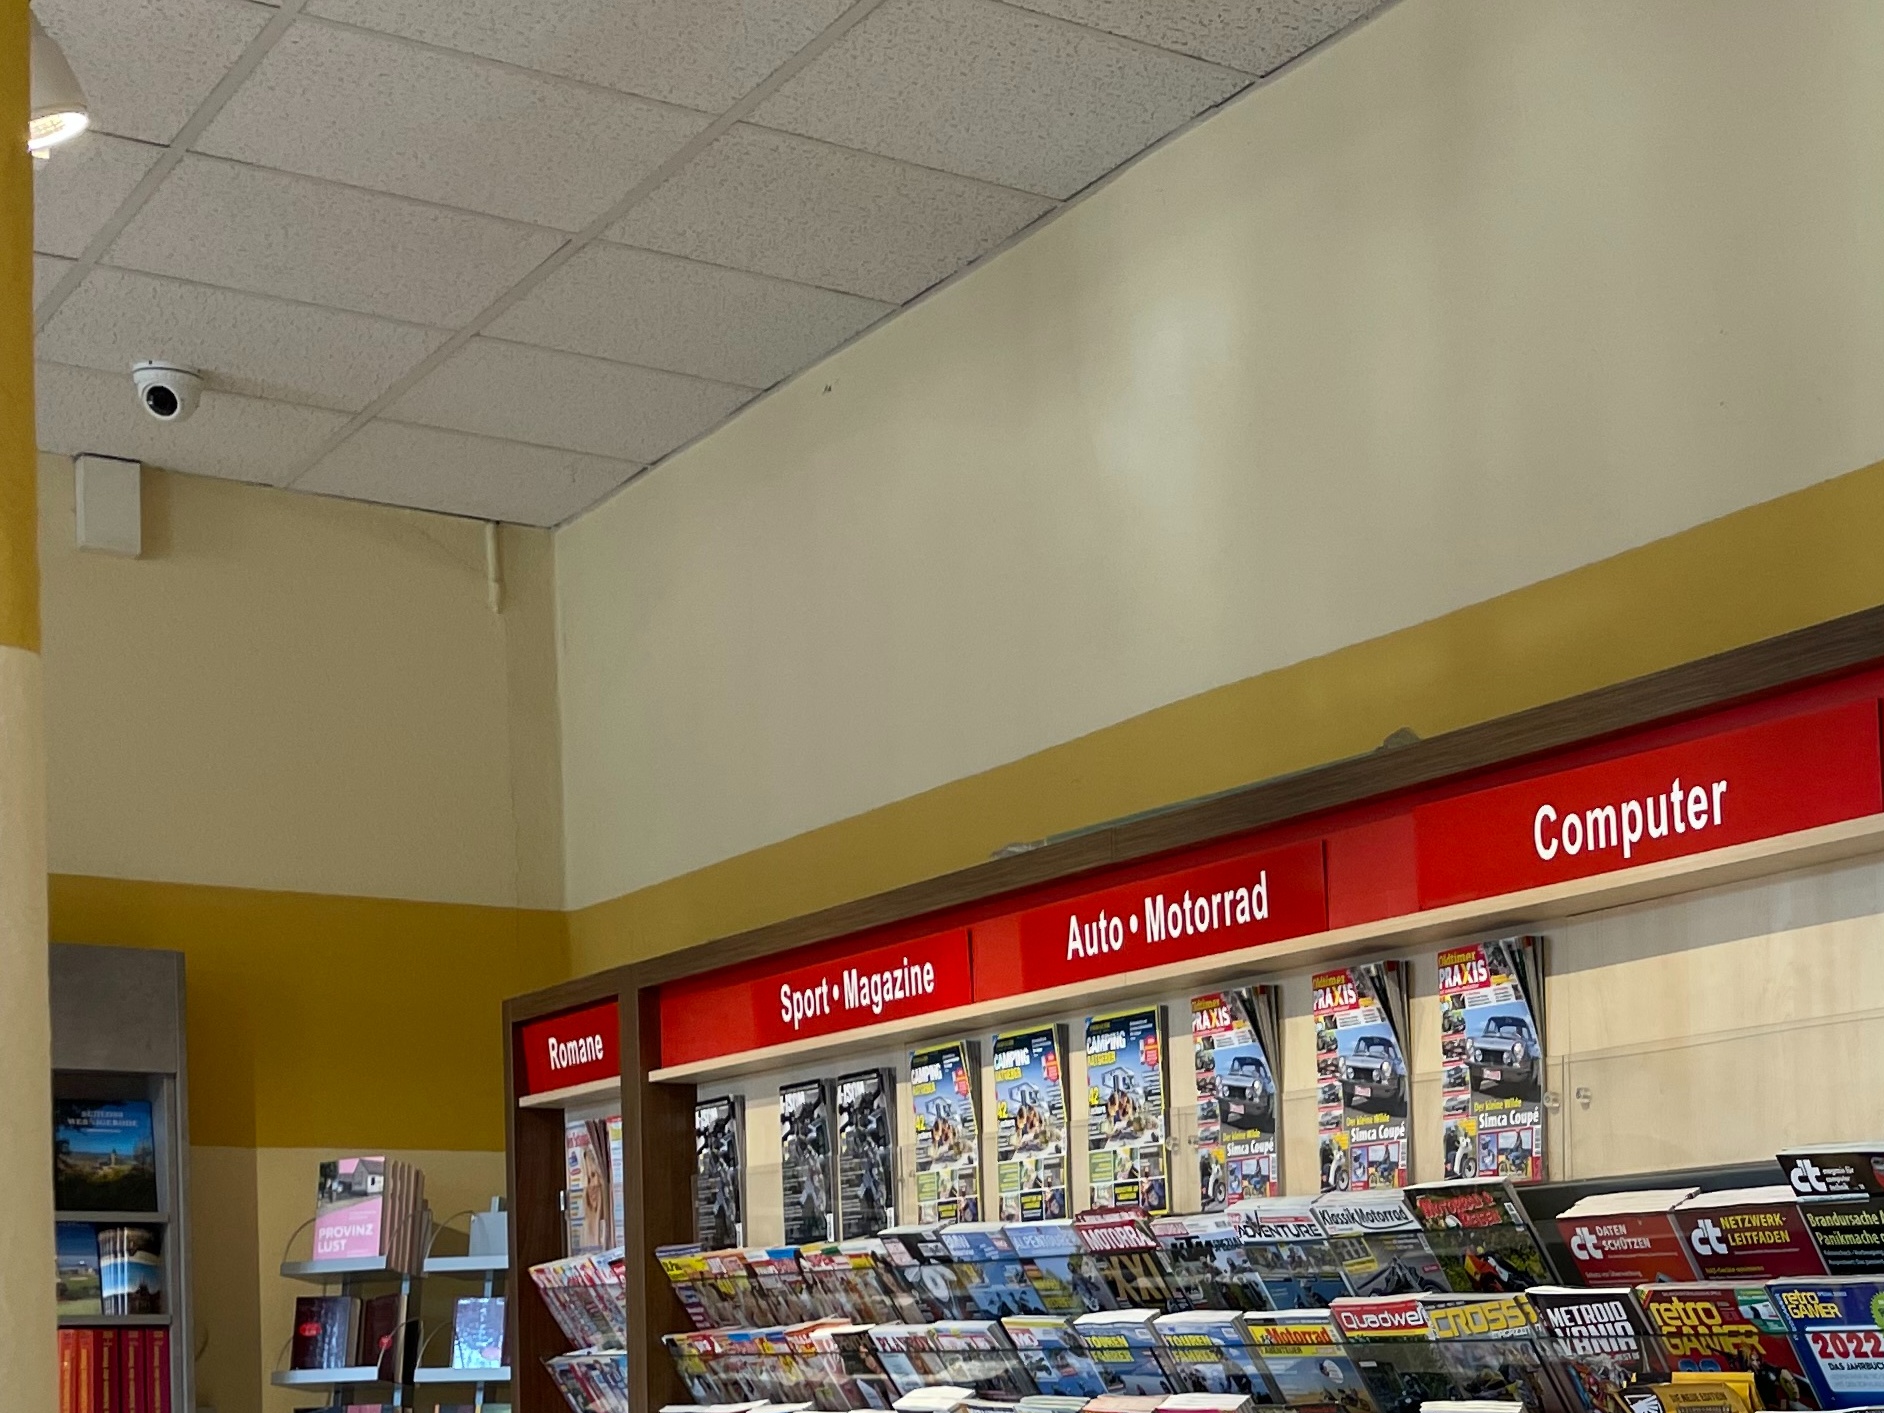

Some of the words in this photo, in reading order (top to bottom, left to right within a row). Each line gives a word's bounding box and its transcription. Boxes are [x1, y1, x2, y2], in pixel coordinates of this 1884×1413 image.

[1533, 776, 1728, 861] Computer
[1067, 913, 1124, 962] Auto
[1144, 870, 1269, 944] Motorrad
[1439, 959, 1488, 989] PRAXIS
[780, 974, 828, 1030] Sport
[843, 958, 935, 1016] Magazine
[548, 1033, 604, 1071] Romane
[1086, 1031, 1126, 1055] CAMPING
[1720, 1214, 1786, 1229] NETZWERK-
[1807, 1210, 1876, 1228] Brandursache
[318, 1223, 374, 1239] PROVINZ
[1595, 1224, 1627, 1237] DATEN
[1729, 1230, 1790, 1245] LEITFADEN
[1816, 1230, 1878, 1246] Panikmache
[317, 1239, 347, 1252] LUST
[1603, 1236, 1651, 1251] SCHÜTZEN
[1782, 1291, 1818, 1306] retro
[1547, 1301, 1626, 1327] METROID
[1787, 1302, 1841, 1320] GAMER
